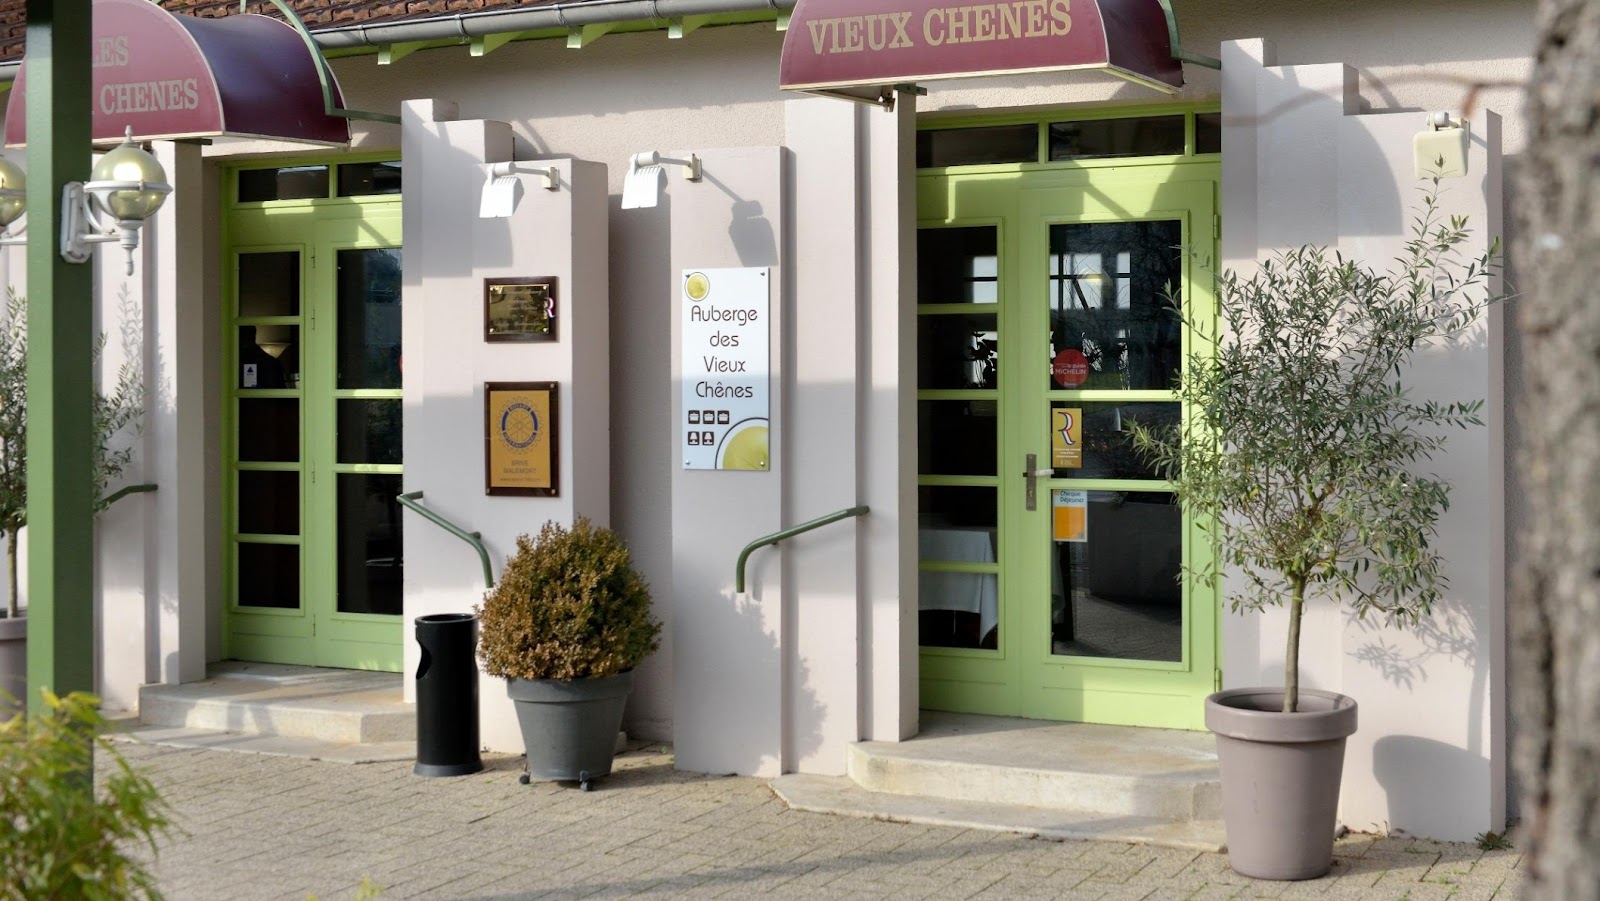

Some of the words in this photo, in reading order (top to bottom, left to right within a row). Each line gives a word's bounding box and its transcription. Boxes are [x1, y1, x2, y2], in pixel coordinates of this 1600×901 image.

[806, 12, 913, 55] VIEUX
[923, 0, 1072, 46] CHENES
[100, 78, 199, 115] CHENES
[691, 305, 758, 326] Auberge
[709, 330, 739, 347] des
[703, 356, 746, 373] Vieux
[695, 381, 753, 398] Chênes
